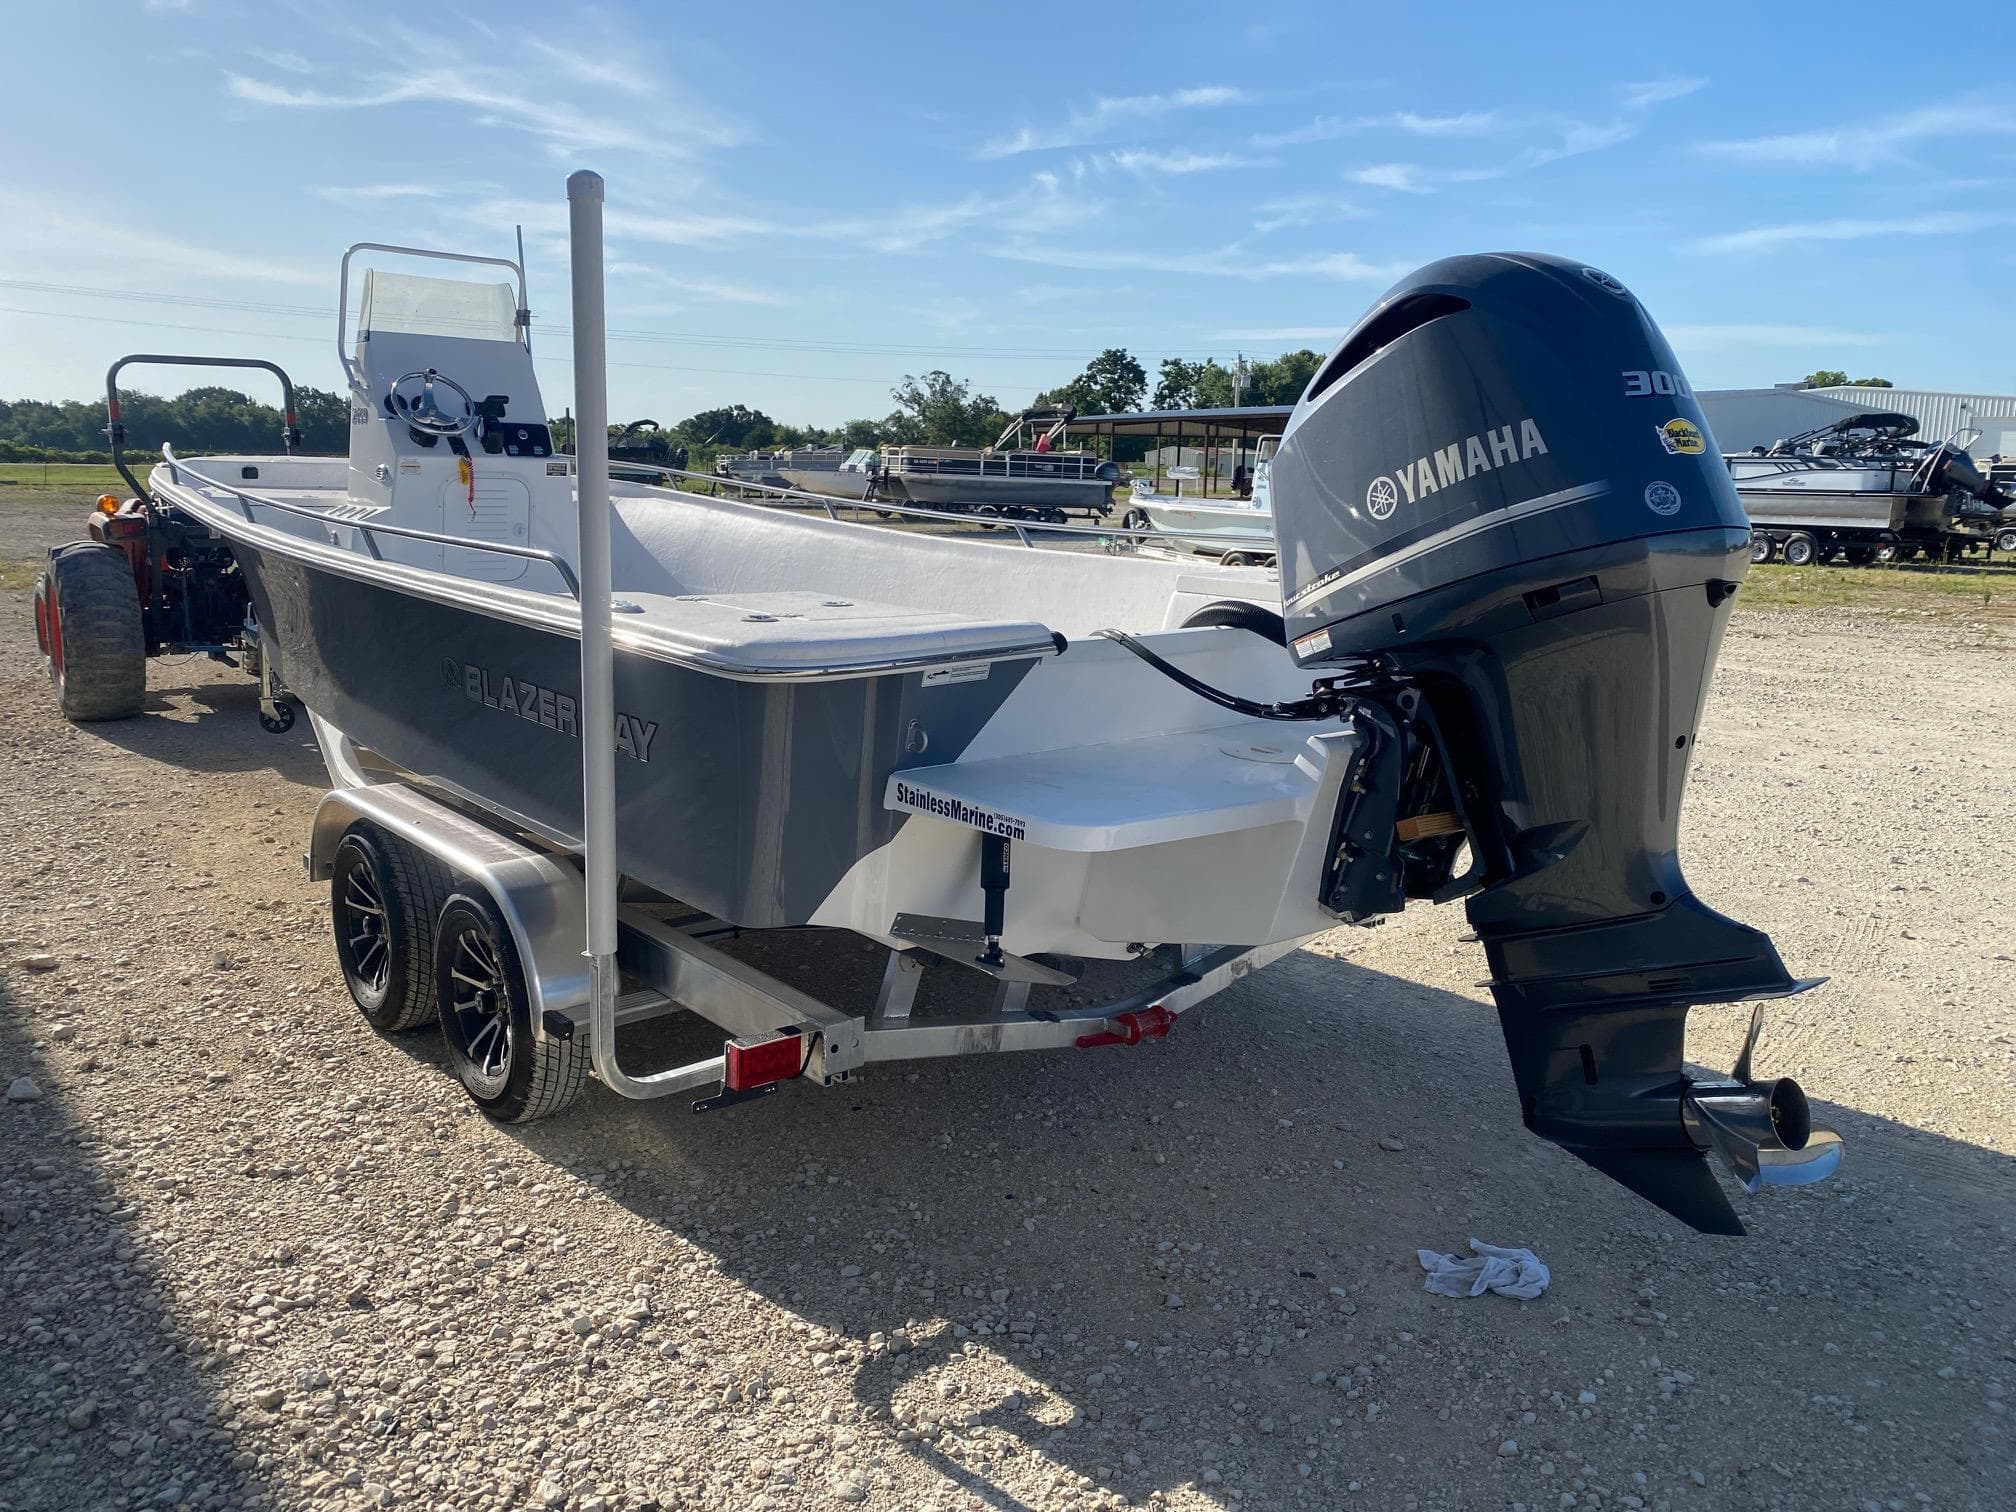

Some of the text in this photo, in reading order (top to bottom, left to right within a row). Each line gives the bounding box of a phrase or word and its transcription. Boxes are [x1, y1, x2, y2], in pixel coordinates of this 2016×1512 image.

[1622, 370, 1693, 400] 300
[1396, 418, 1549, 504] YAMAHA
[1284, 571, 1341, 607] ourstroke
[464, 663, 659, 763] BLAZER AY
[896, 782, 1025, 841] StainlessMarine.com
